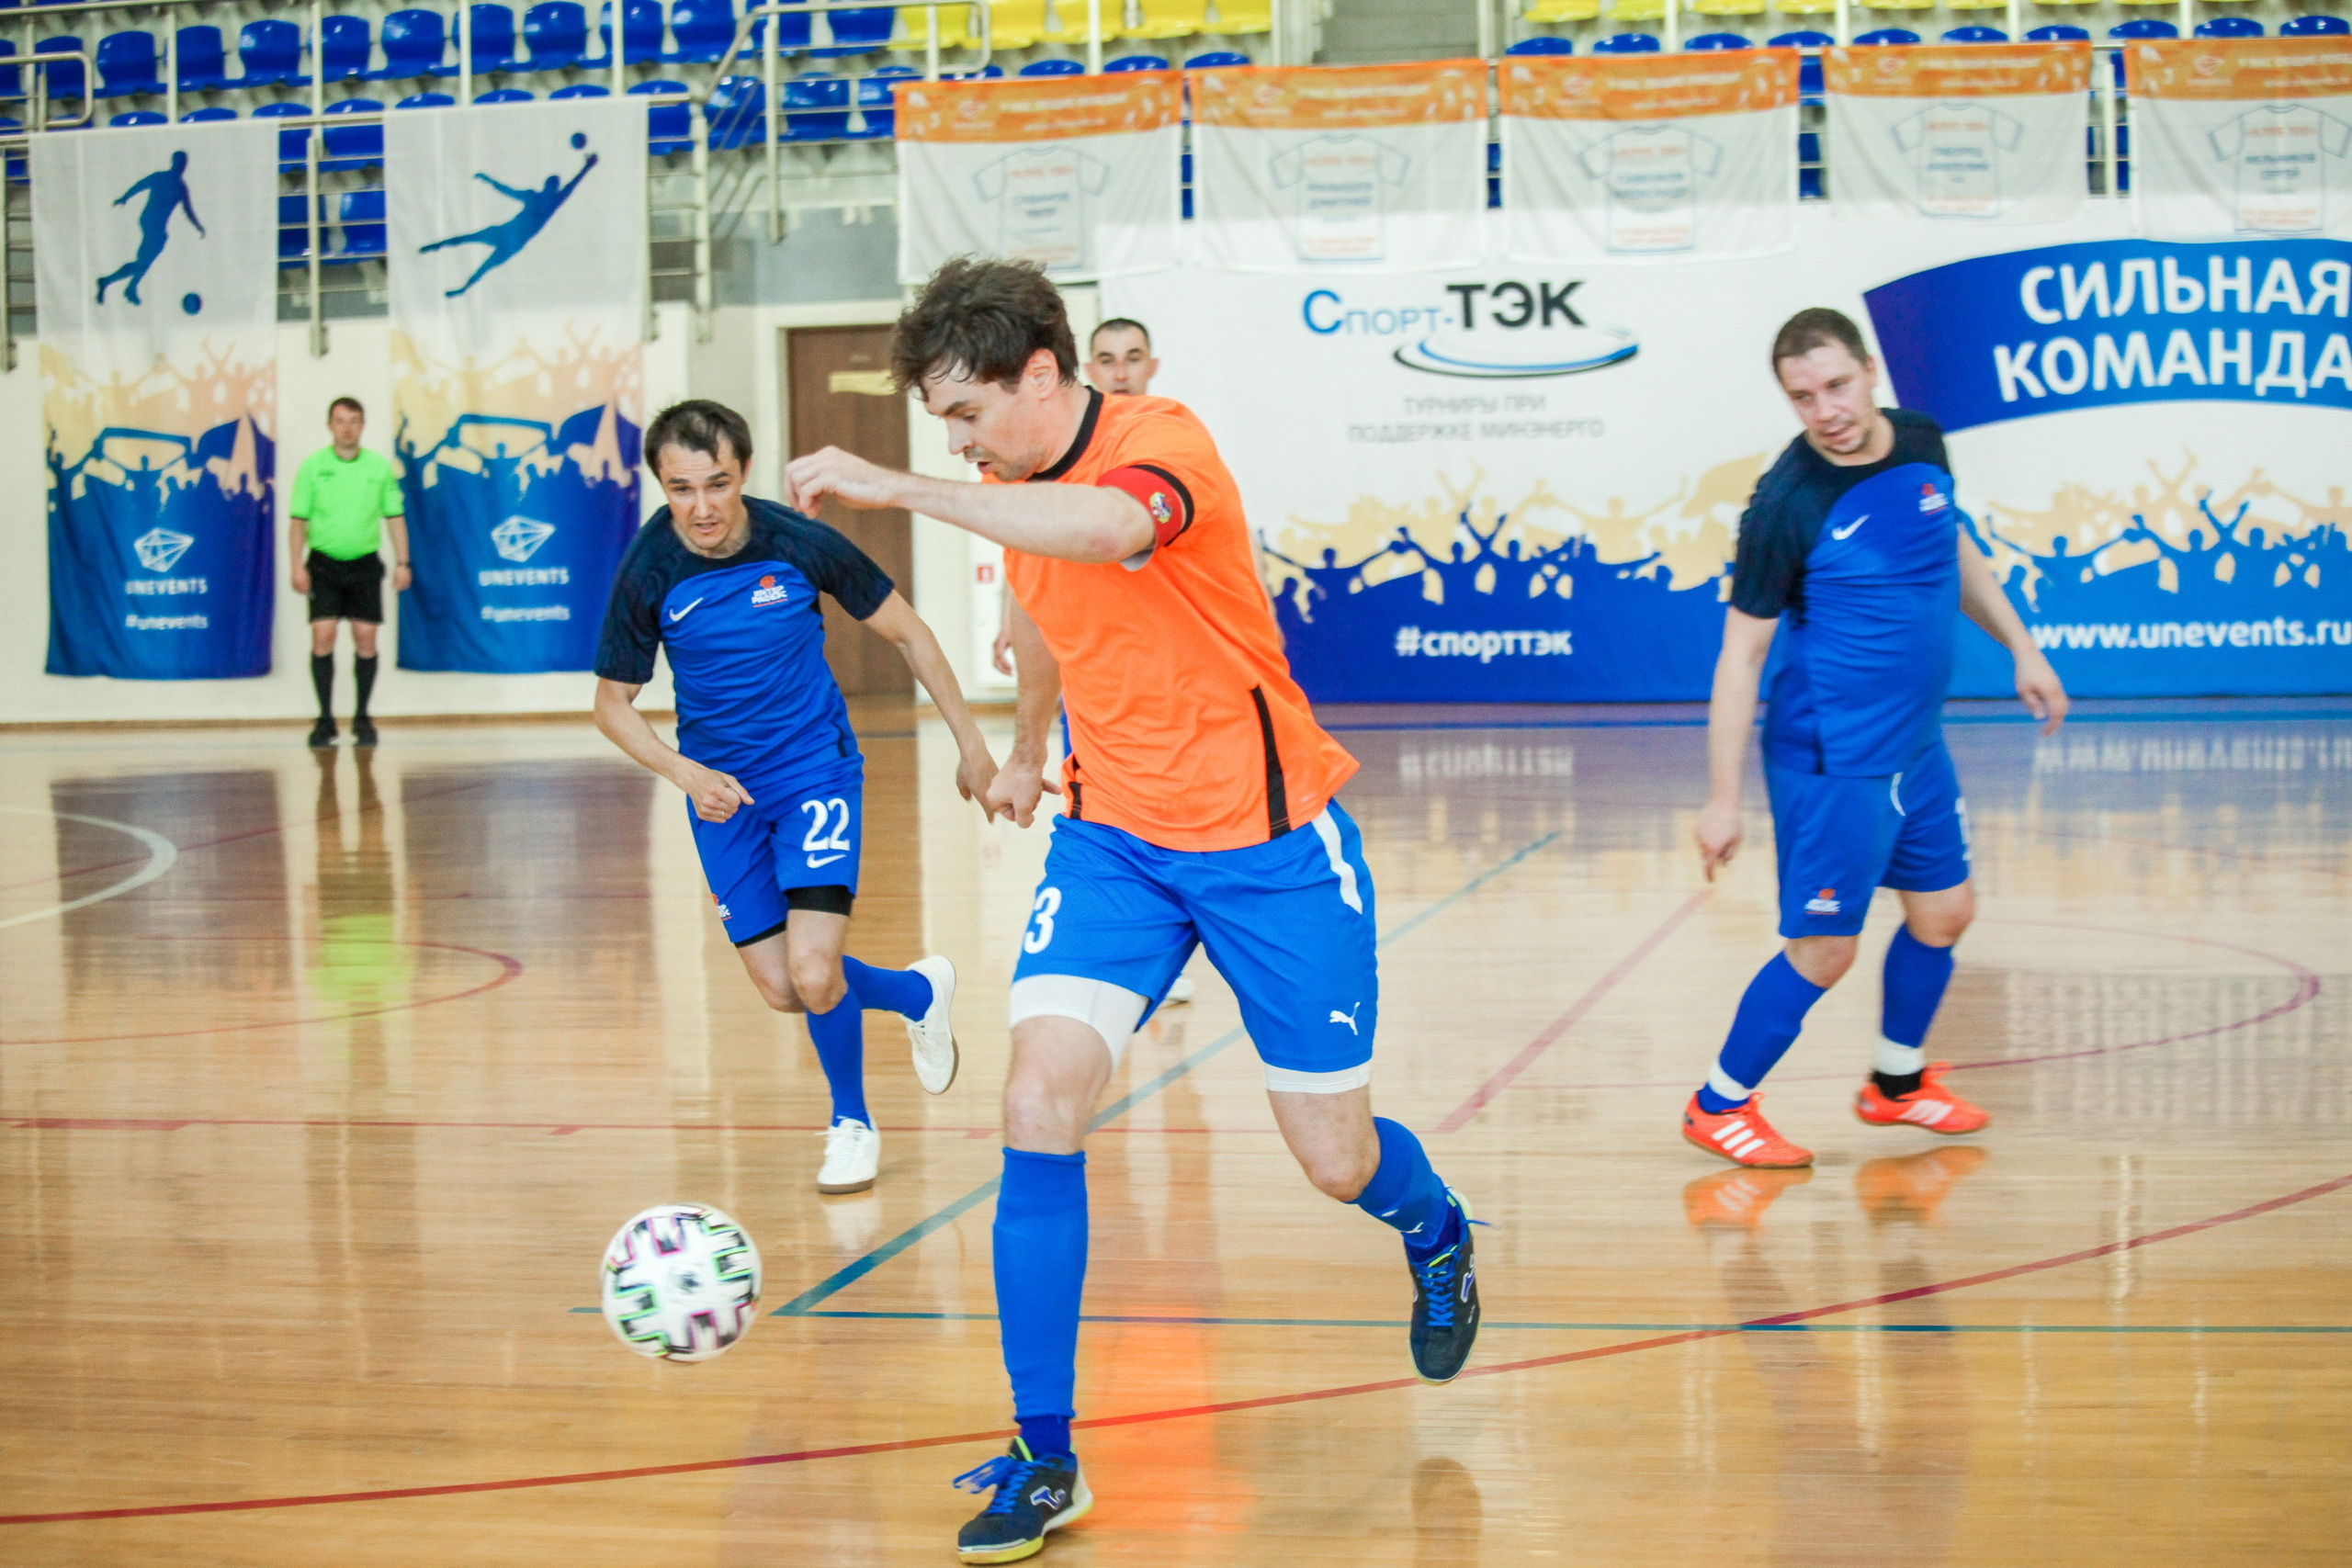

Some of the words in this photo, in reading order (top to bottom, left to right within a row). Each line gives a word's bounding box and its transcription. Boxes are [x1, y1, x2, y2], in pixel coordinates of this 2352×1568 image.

[2020, 254, 2352, 325] СИЛЬНАЯ
[1993, 327, 2352, 402] КОМАНДА
[1403, 395, 1498, 415] ТУРНИРЫ
[1503, 393, 1546, 412] ПРИ
[1348, 421, 1473, 444] ПОДДЕРЖКЕ
[479, 567, 570, 587] UNEVENTS
[125, 614, 209, 630] #unevents
[481, 605, 571, 623] #unevents
[1395, 626, 1574, 663] #спорттэк
[2030, 615, 2352, 649] www.unevents.ru
[800, 797, 851, 852] 22
[1023, 886, 1062, 954] 3
